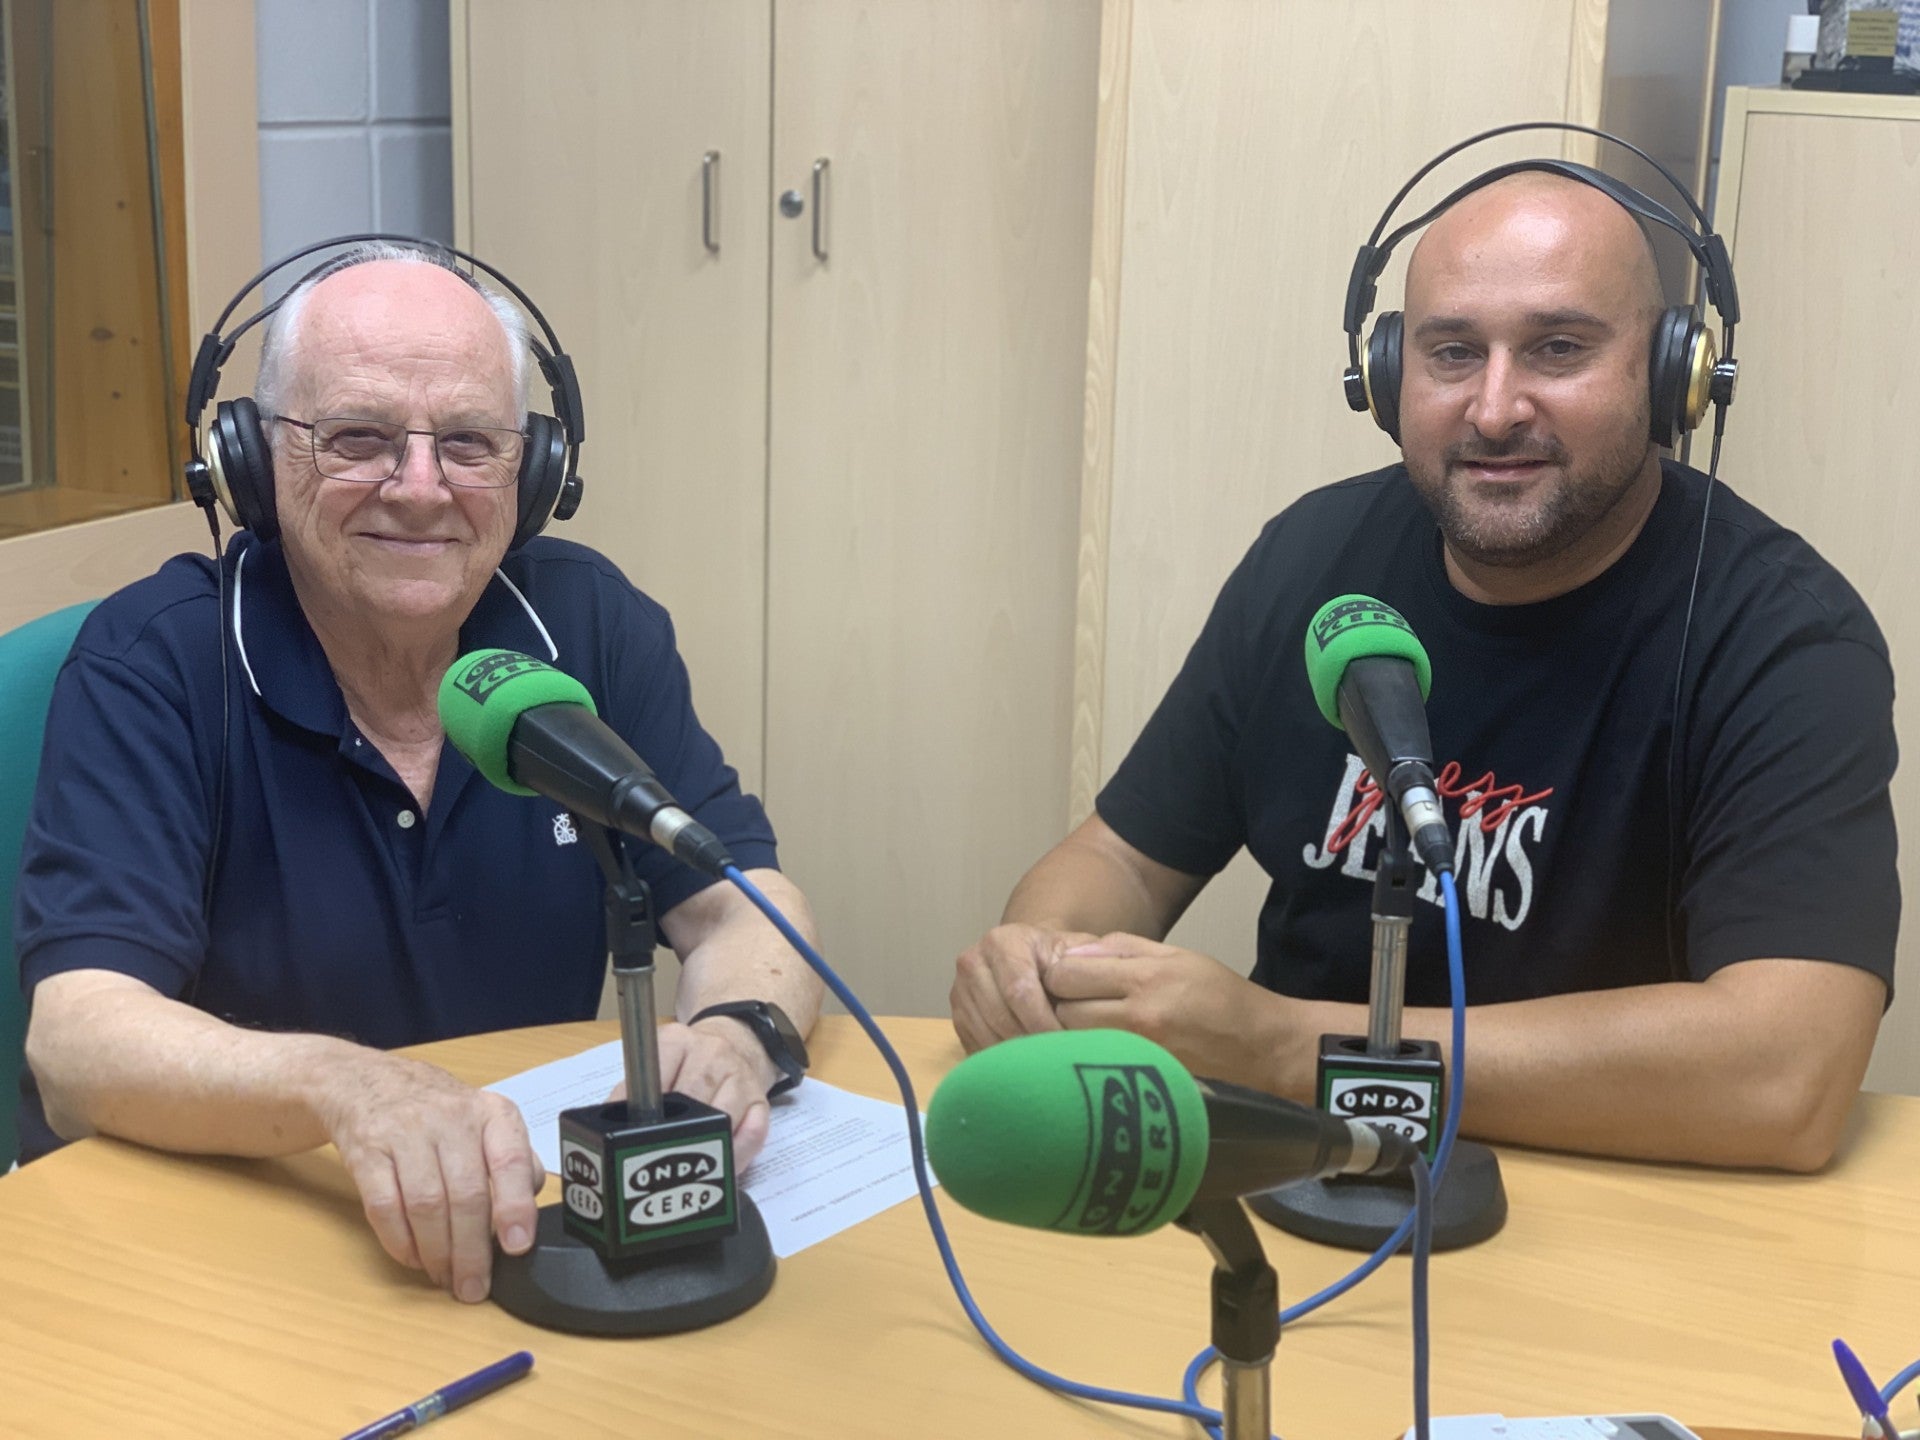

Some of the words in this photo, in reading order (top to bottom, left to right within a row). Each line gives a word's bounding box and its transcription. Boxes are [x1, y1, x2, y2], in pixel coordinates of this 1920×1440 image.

[1343, 1091, 1417, 1110] ONDA
[1087, 1091, 1130, 1222] ONDA
[1128, 1089, 1168, 1220] CERO
[636, 1157, 710, 1187] ONDA
[643, 1190, 711, 1218] CERO
